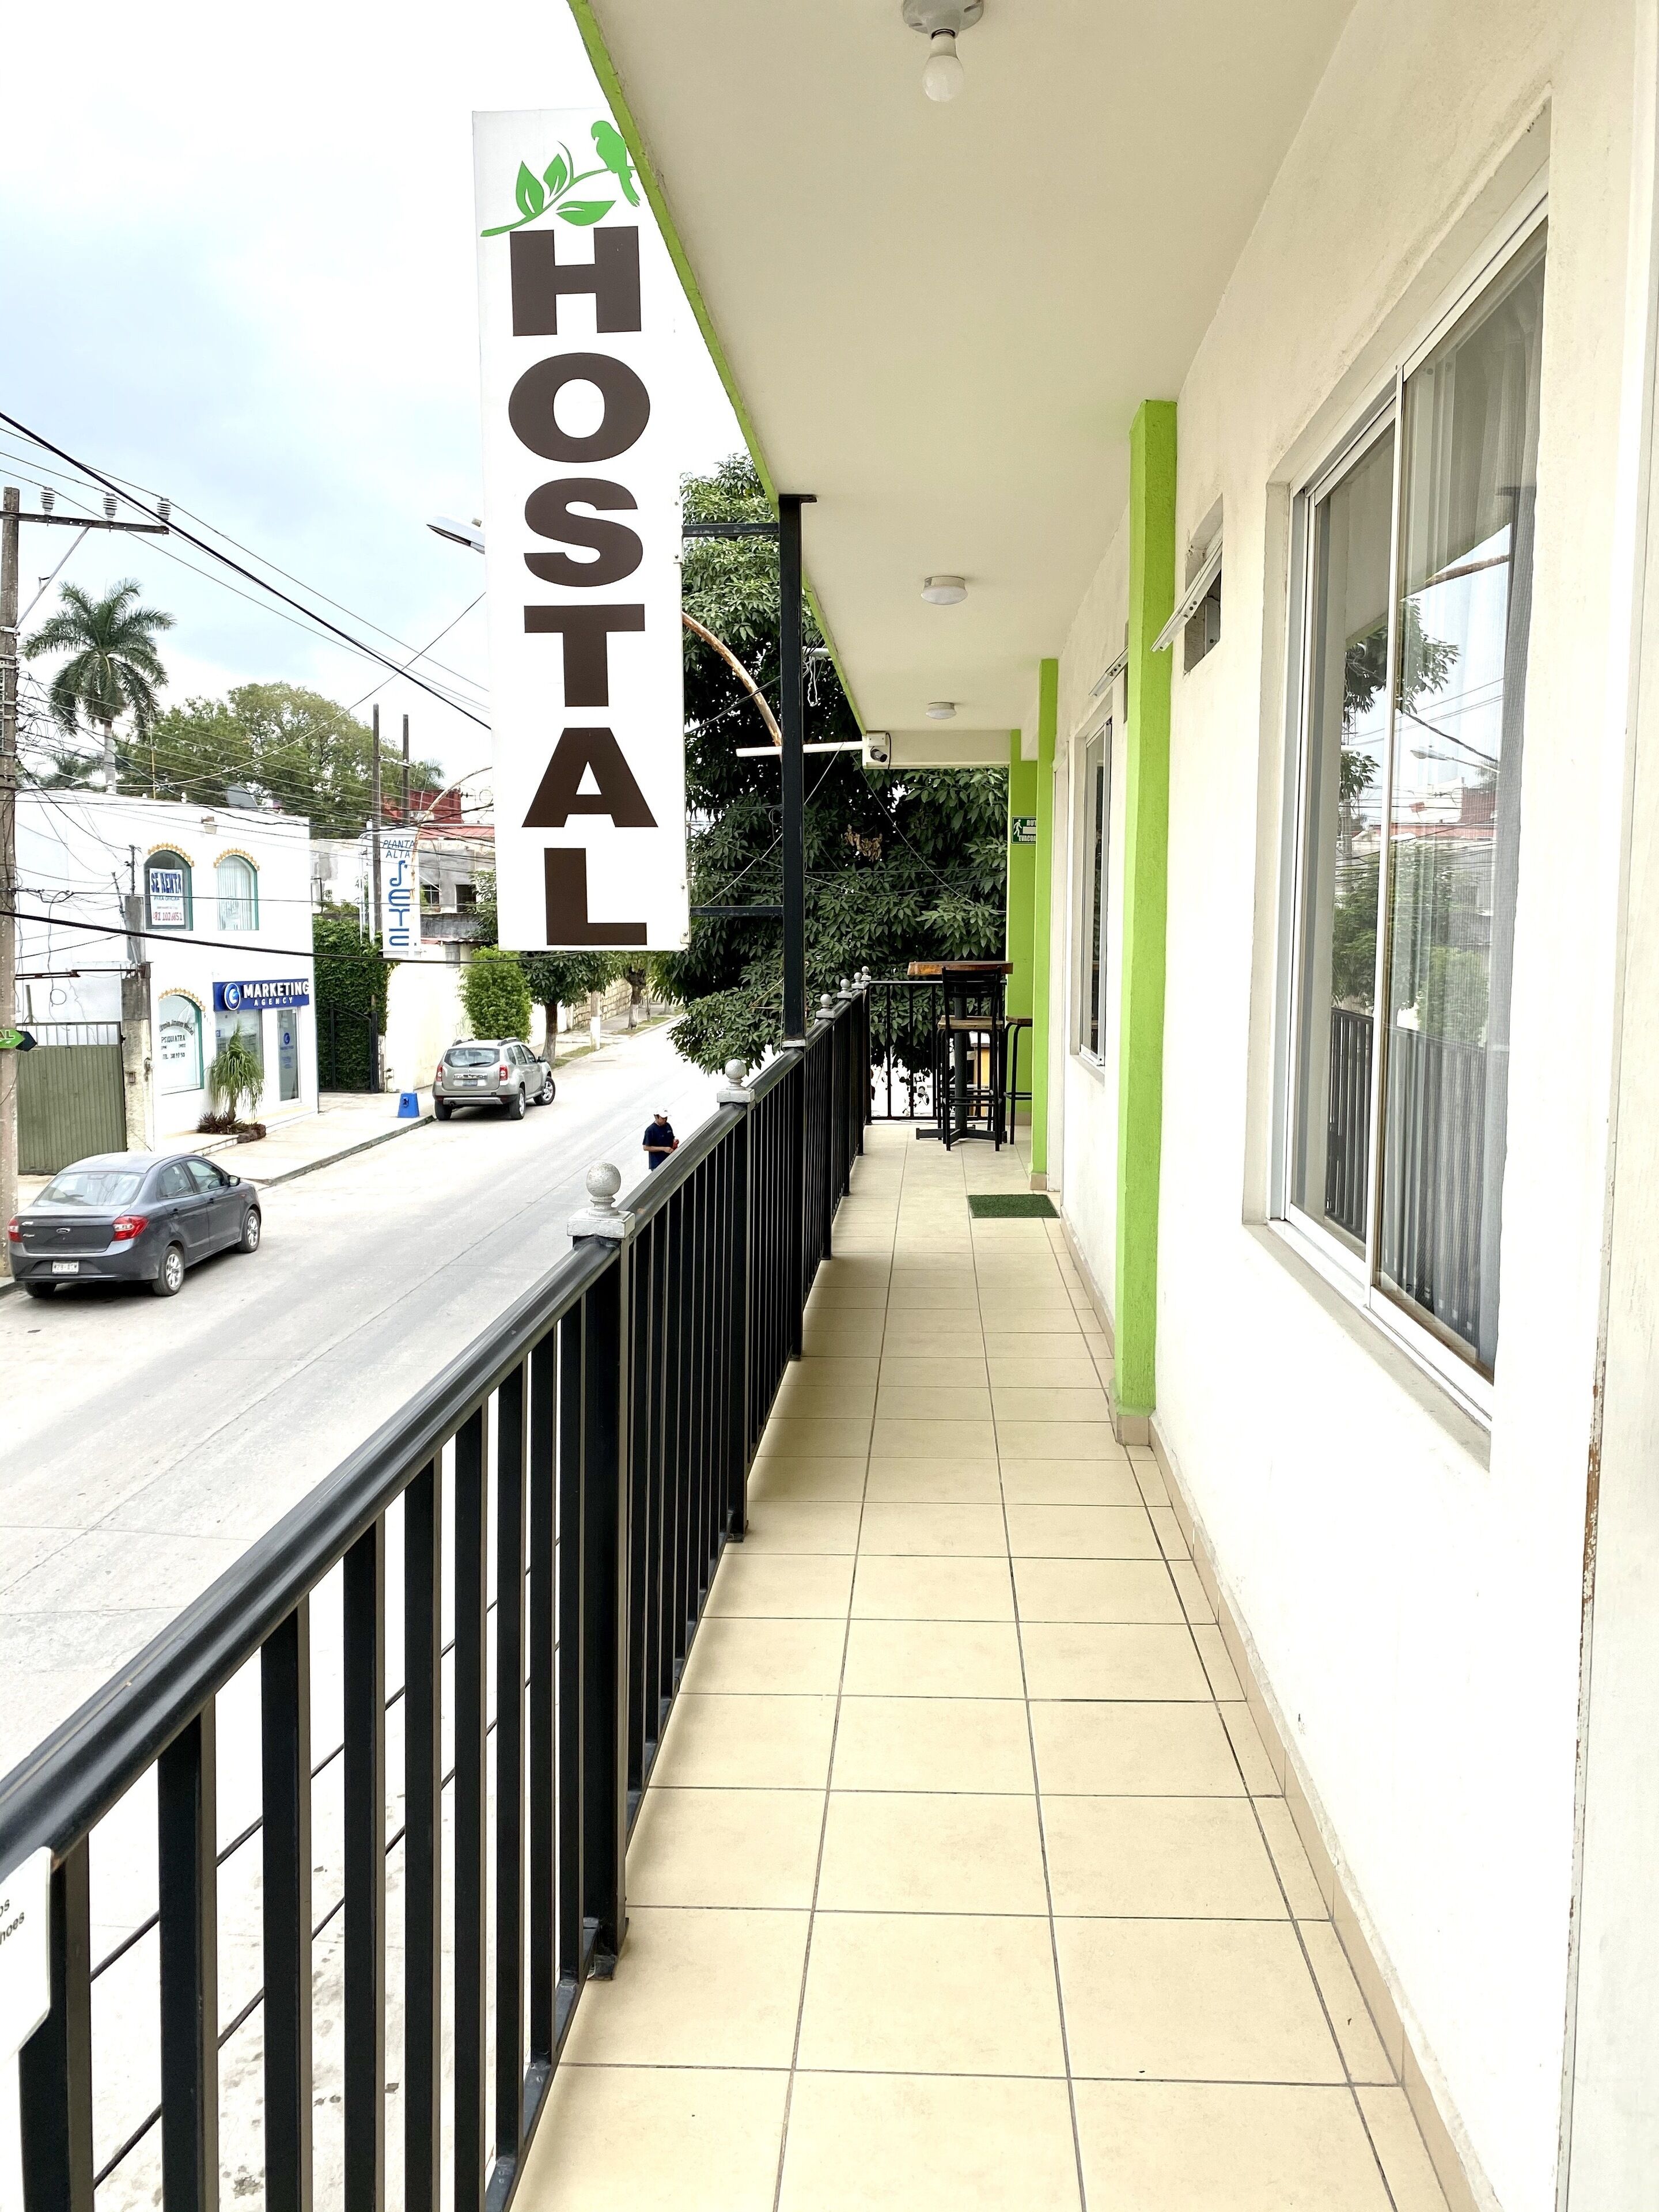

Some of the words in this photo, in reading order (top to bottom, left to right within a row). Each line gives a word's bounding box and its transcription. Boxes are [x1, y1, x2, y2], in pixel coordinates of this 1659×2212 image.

[508, 226, 658, 946] HOSTAL
[382, 840, 415, 849] PLANTA
[385, 850, 410, 858] ALTA
[151, 872, 160, 893] SE
[160, 873, 181, 894] RENTA
[243, 981, 309, 999] MARKETING
[254, 997, 293, 1006] AGENCY
